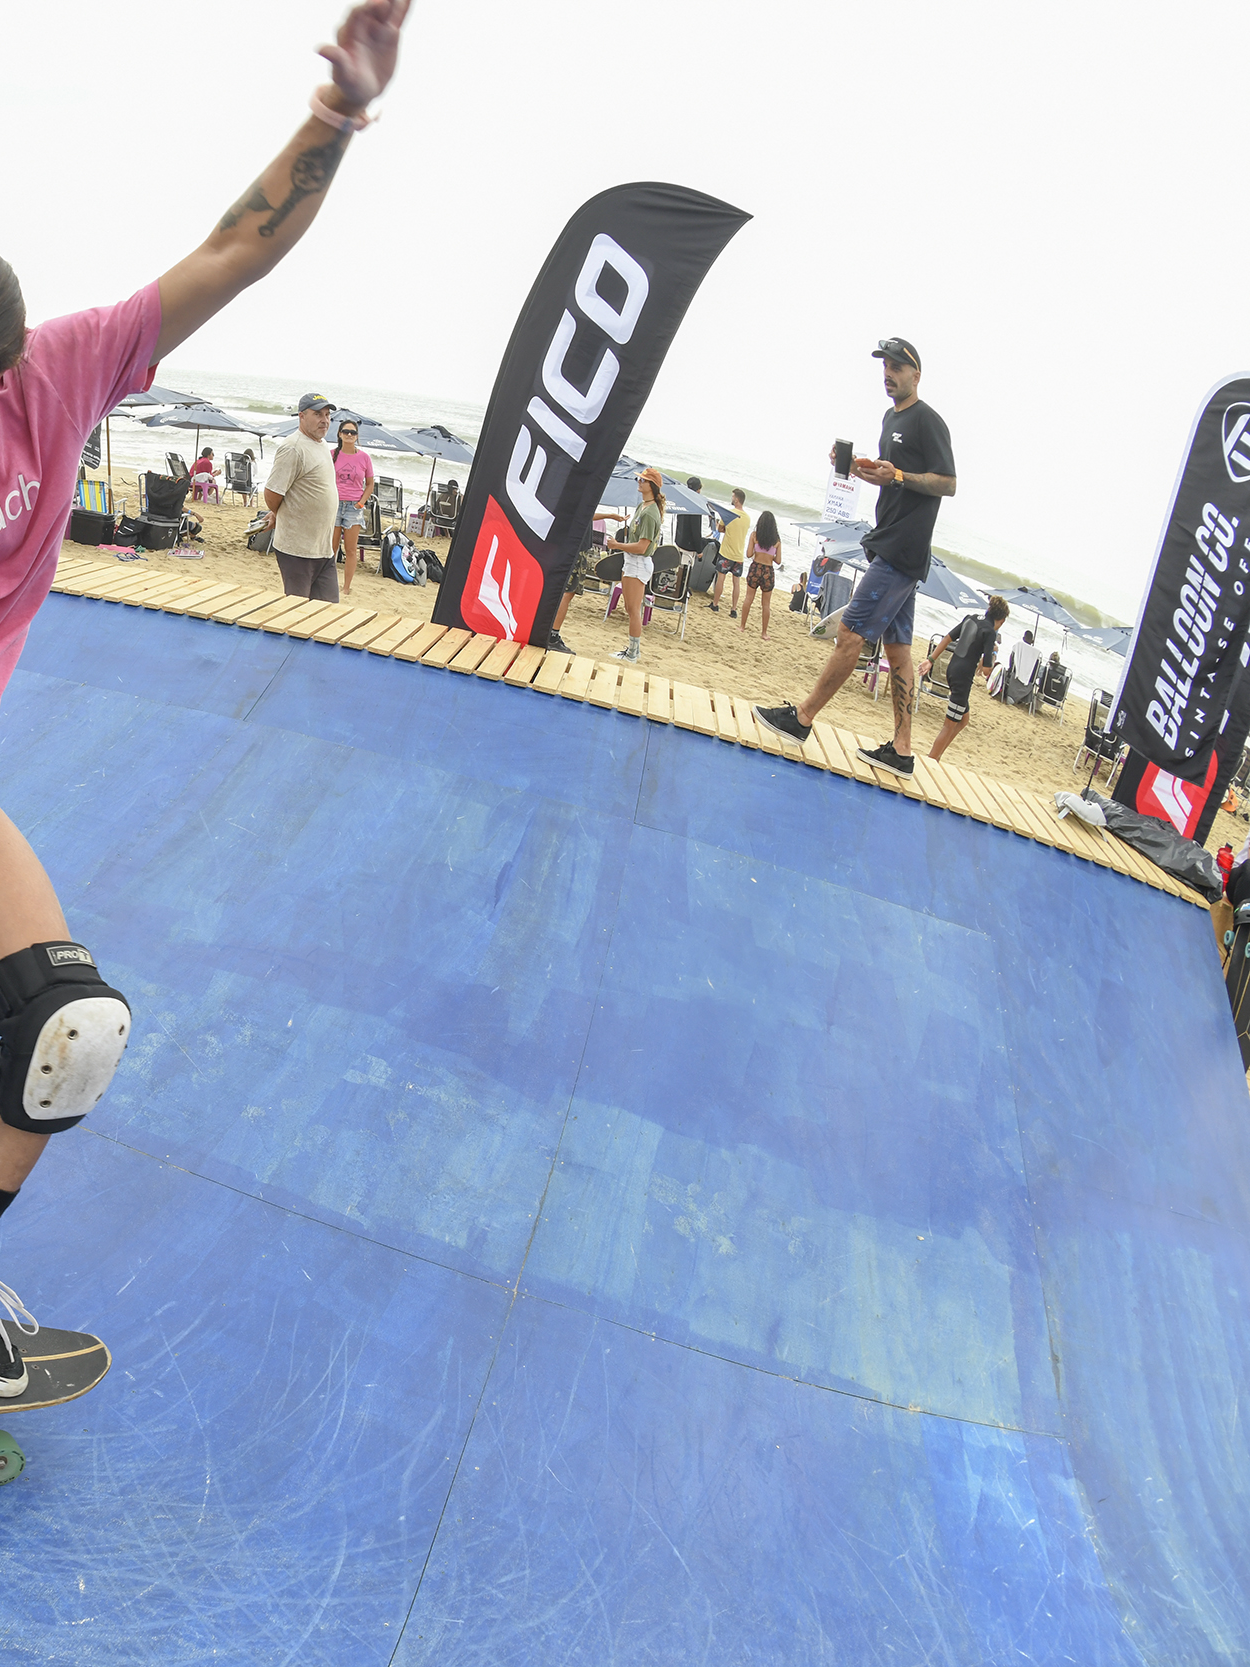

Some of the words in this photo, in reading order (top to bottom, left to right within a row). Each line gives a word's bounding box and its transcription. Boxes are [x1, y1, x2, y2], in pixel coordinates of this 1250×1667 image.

[504, 232, 650, 541] FICO
[825, 507, 837, 515] 250
[838, 510, 851, 519] ABS
[837, 482, 855, 492] YAMAHA
[1145, 554, 1222, 751] BALLOON
[1195, 502, 1240, 573] CO.
